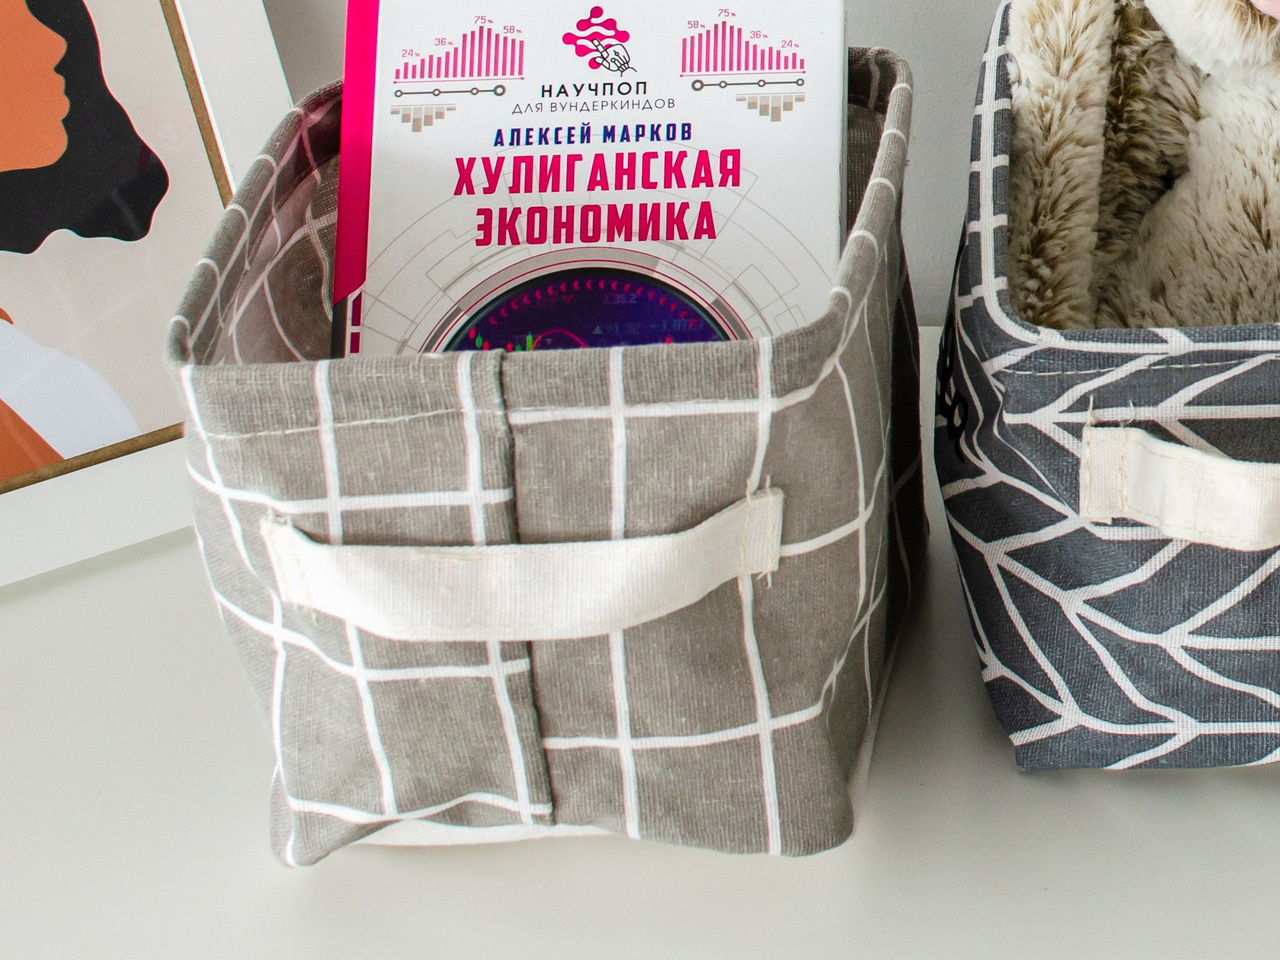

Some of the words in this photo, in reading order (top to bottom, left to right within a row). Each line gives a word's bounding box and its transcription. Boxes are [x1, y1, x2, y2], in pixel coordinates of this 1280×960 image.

[541, 81, 648, 98] НАУЧПОП
[511, 102, 543, 115] ДЛЯ
[550, 98, 676, 113] ВУНДЕРКИНДОВ
[493, 122, 591, 147] АЛЕКСЕЙ
[602, 122, 692, 144] МАРКОВ
[453, 149, 741, 196] ХУЛИГАНСКАЯ
[475, 200, 717, 247] ЭКОНОМИКА
